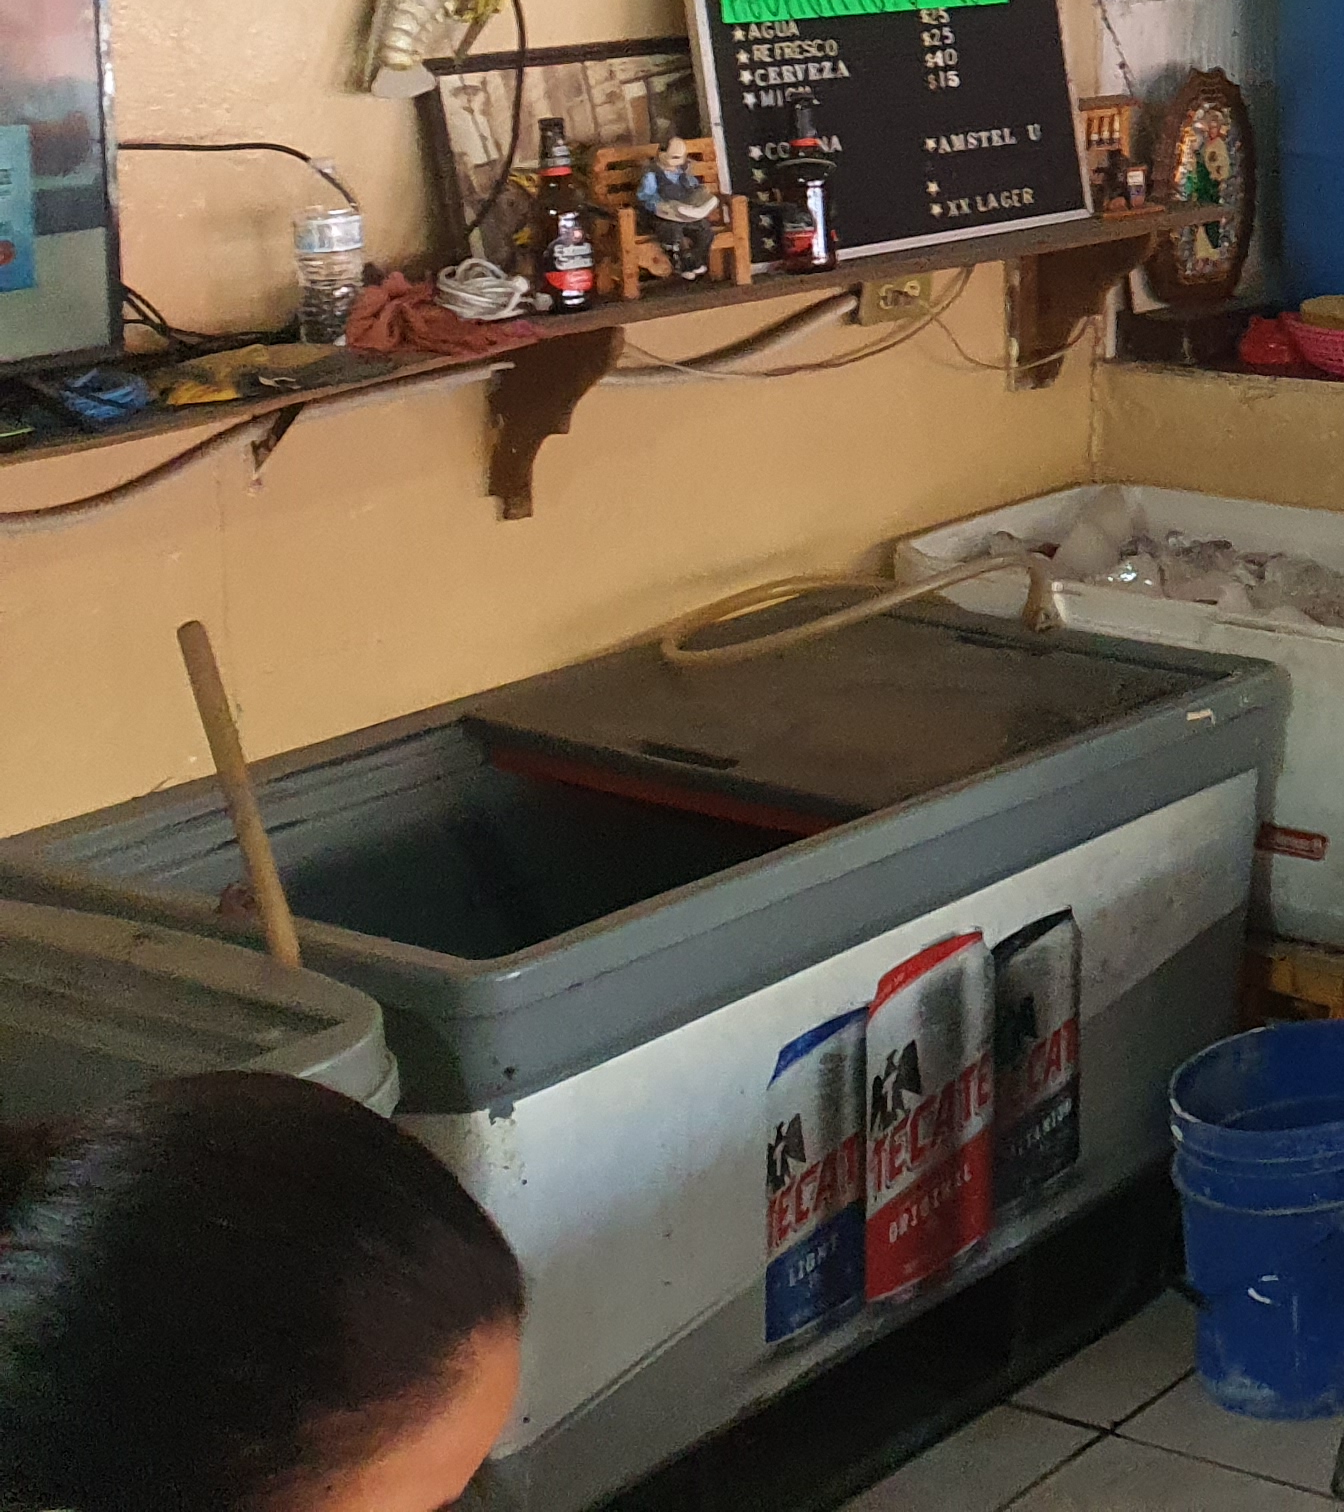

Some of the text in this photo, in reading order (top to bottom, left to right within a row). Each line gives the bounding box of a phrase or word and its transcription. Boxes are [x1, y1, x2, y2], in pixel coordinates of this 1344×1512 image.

[748, 20, 799, 40] AGUA
[751, 38, 837, 63] REFRESCO
[753, 59, 849, 87] CERVEZA
[765, 135, 843, 160] CONA
[939, 128, 1015, 153] AMSTEL
[976, 188, 1033, 211] LAGER
